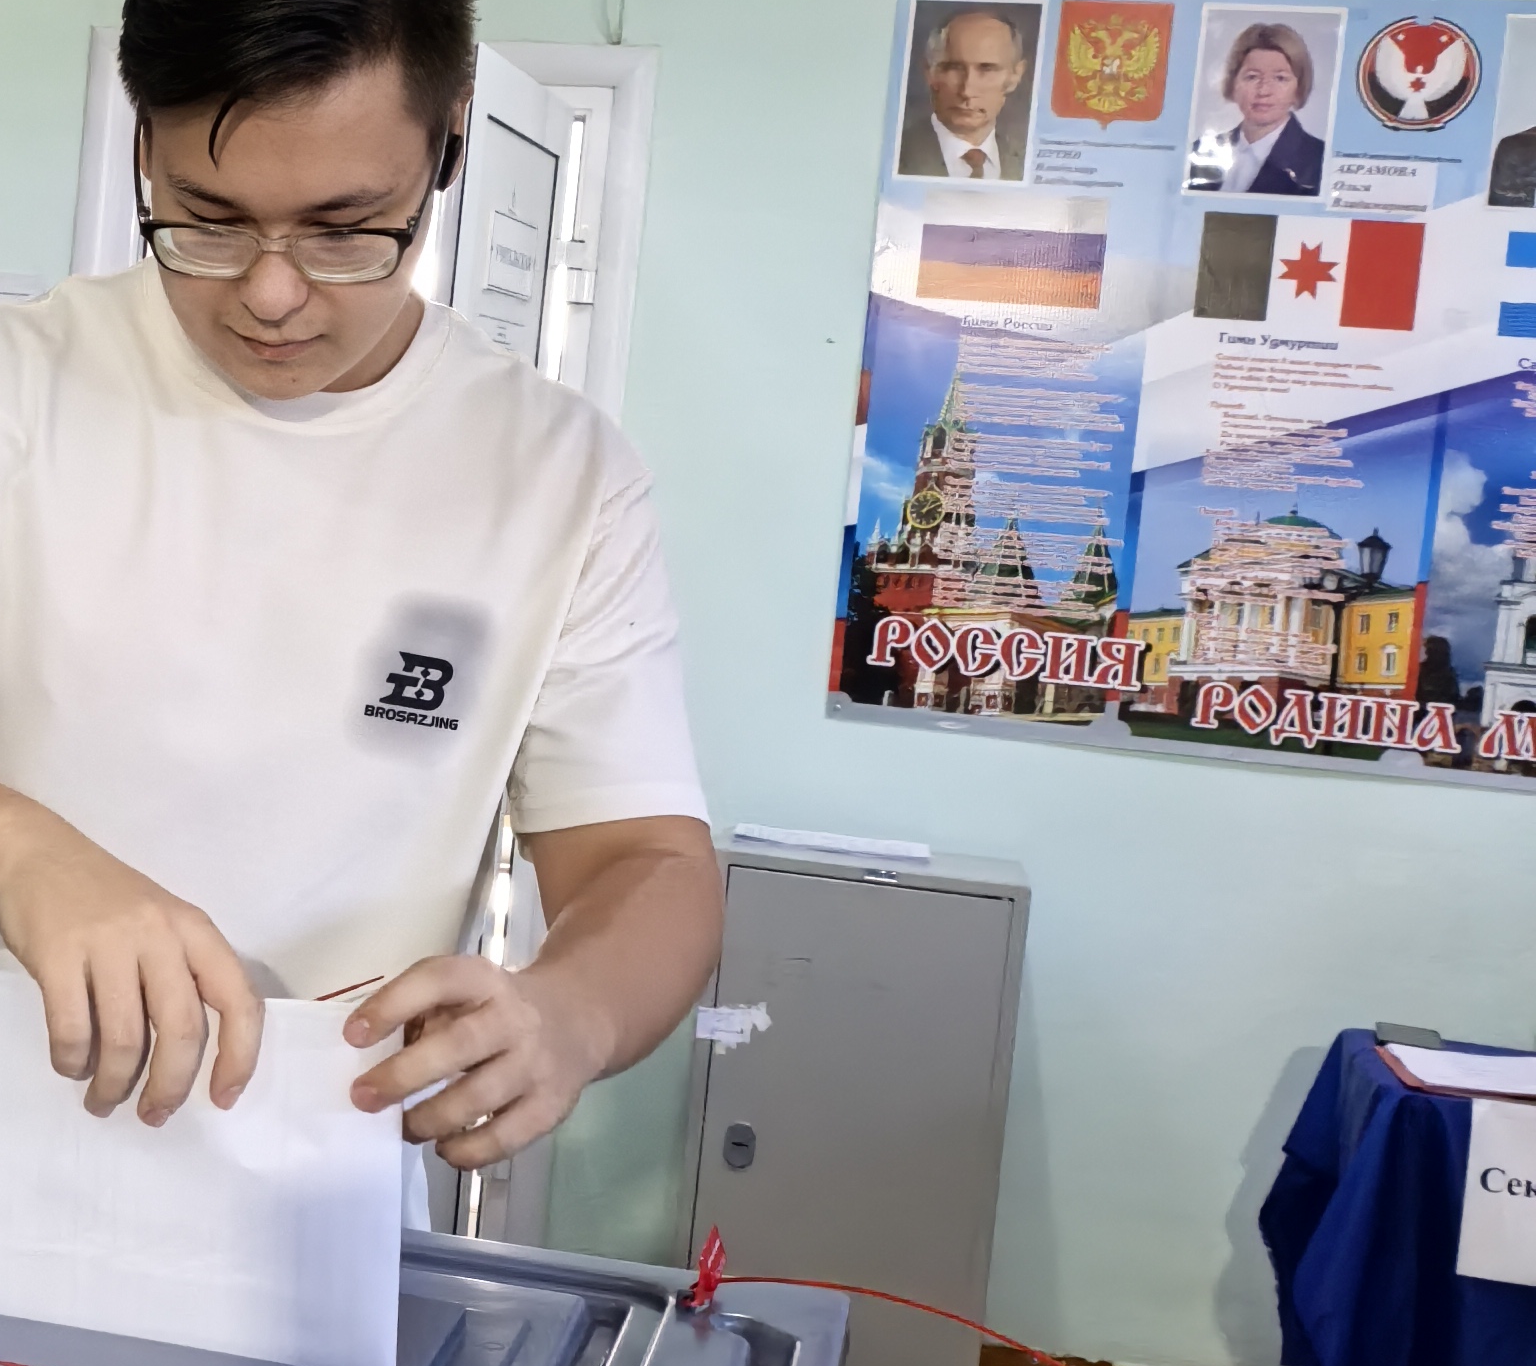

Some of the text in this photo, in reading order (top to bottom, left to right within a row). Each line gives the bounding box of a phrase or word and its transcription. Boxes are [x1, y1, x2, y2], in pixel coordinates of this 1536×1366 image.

[866, 616, 1145, 691] РОССИЯ
[364, 704, 459, 731] BROSAZJING
[1191, 681, 1461, 754] РОДИНА
